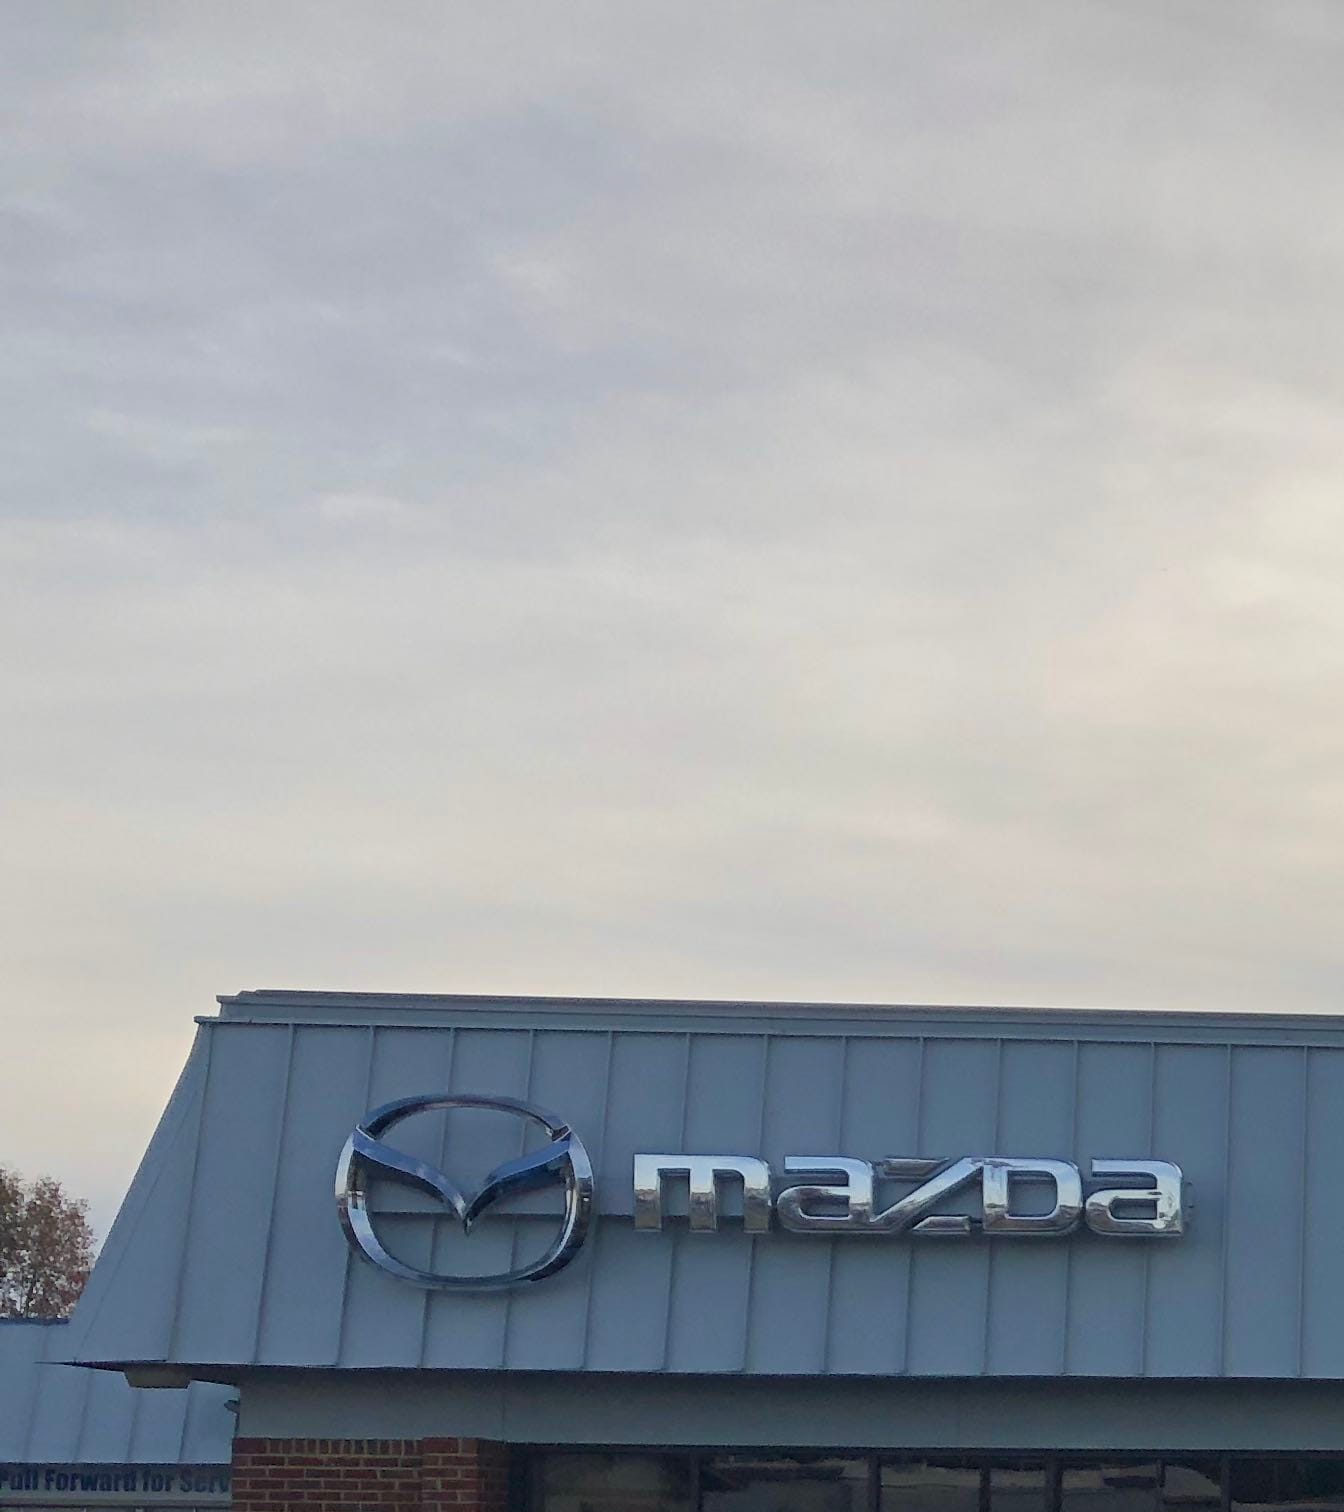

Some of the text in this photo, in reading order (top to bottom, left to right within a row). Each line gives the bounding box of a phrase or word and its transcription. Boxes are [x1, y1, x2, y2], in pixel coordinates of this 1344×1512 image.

[633, 1153, 1184, 1236] mazda
[45, 1470, 136, 1491] Forward
[143, 1470, 173, 1492] for
